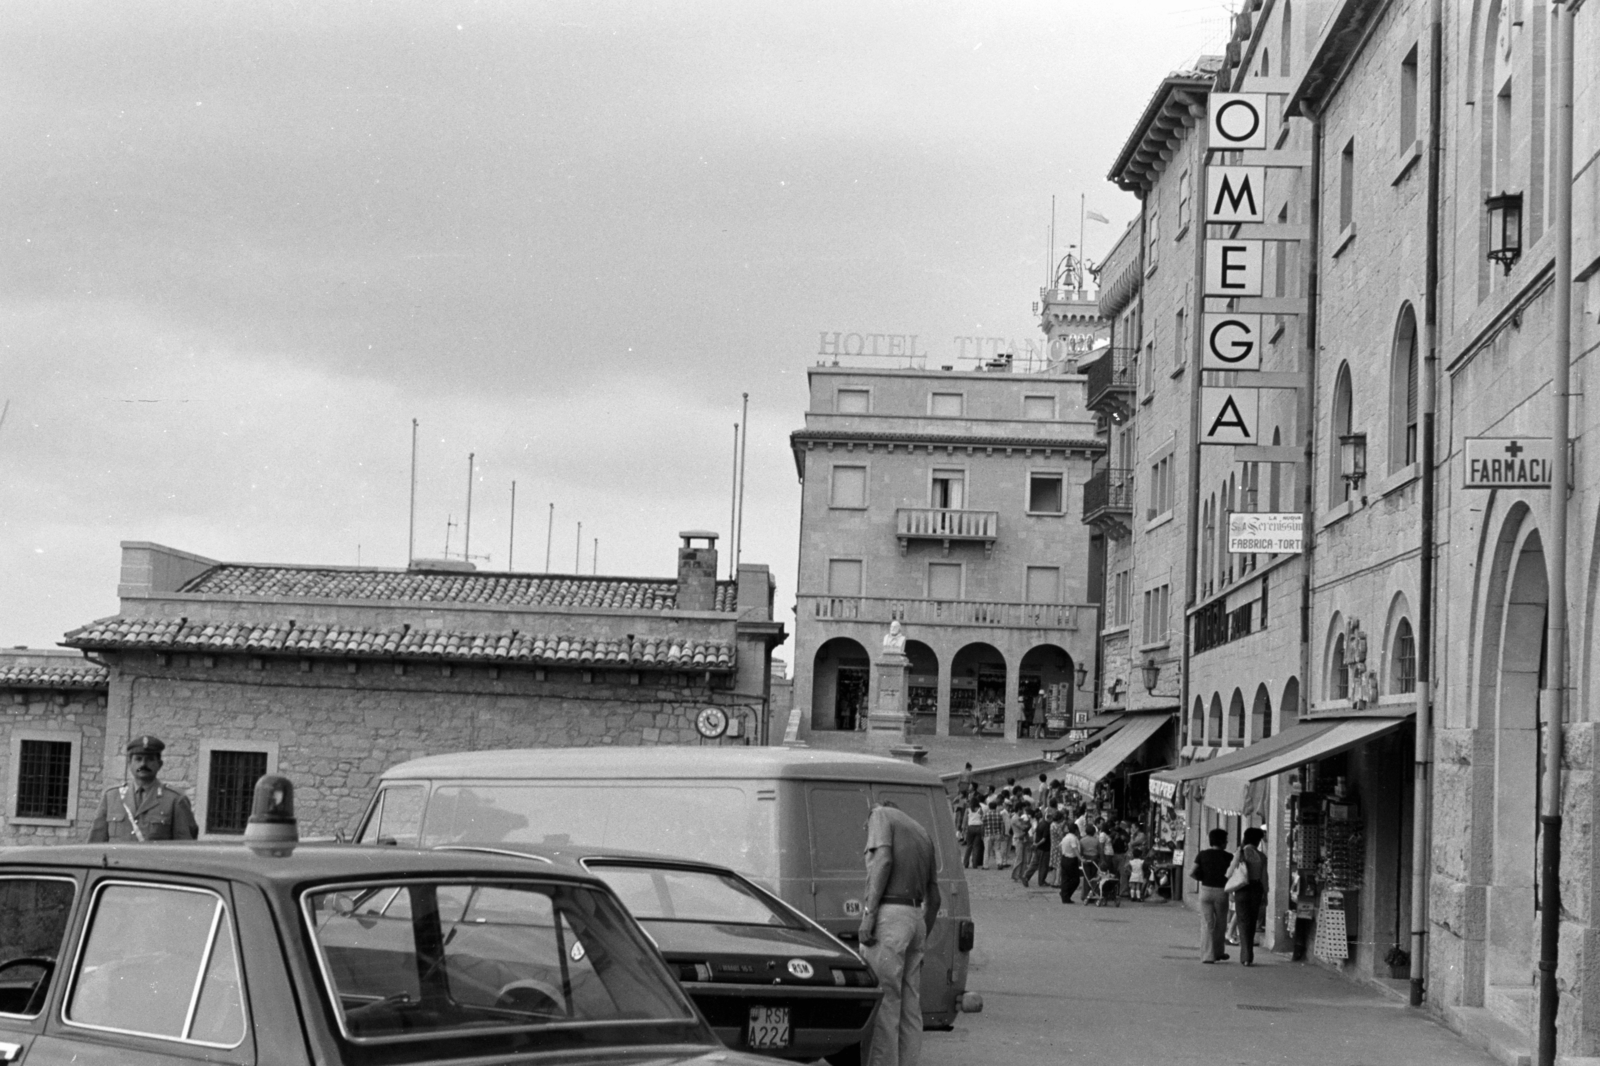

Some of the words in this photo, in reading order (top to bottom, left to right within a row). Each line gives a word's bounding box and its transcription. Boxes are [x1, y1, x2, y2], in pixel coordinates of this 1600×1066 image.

[1206, 99, 1260, 438] OMEGA
[818, 332, 927, 358] HOTEL
[953, 335, 1068, 362] TITANO
[846, 902, 860, 913] RSM
[791, 963, 810, 975] RSM
[765, 1008, 789, 1024] RSM
[749, 1026, 789, 1047] A224
